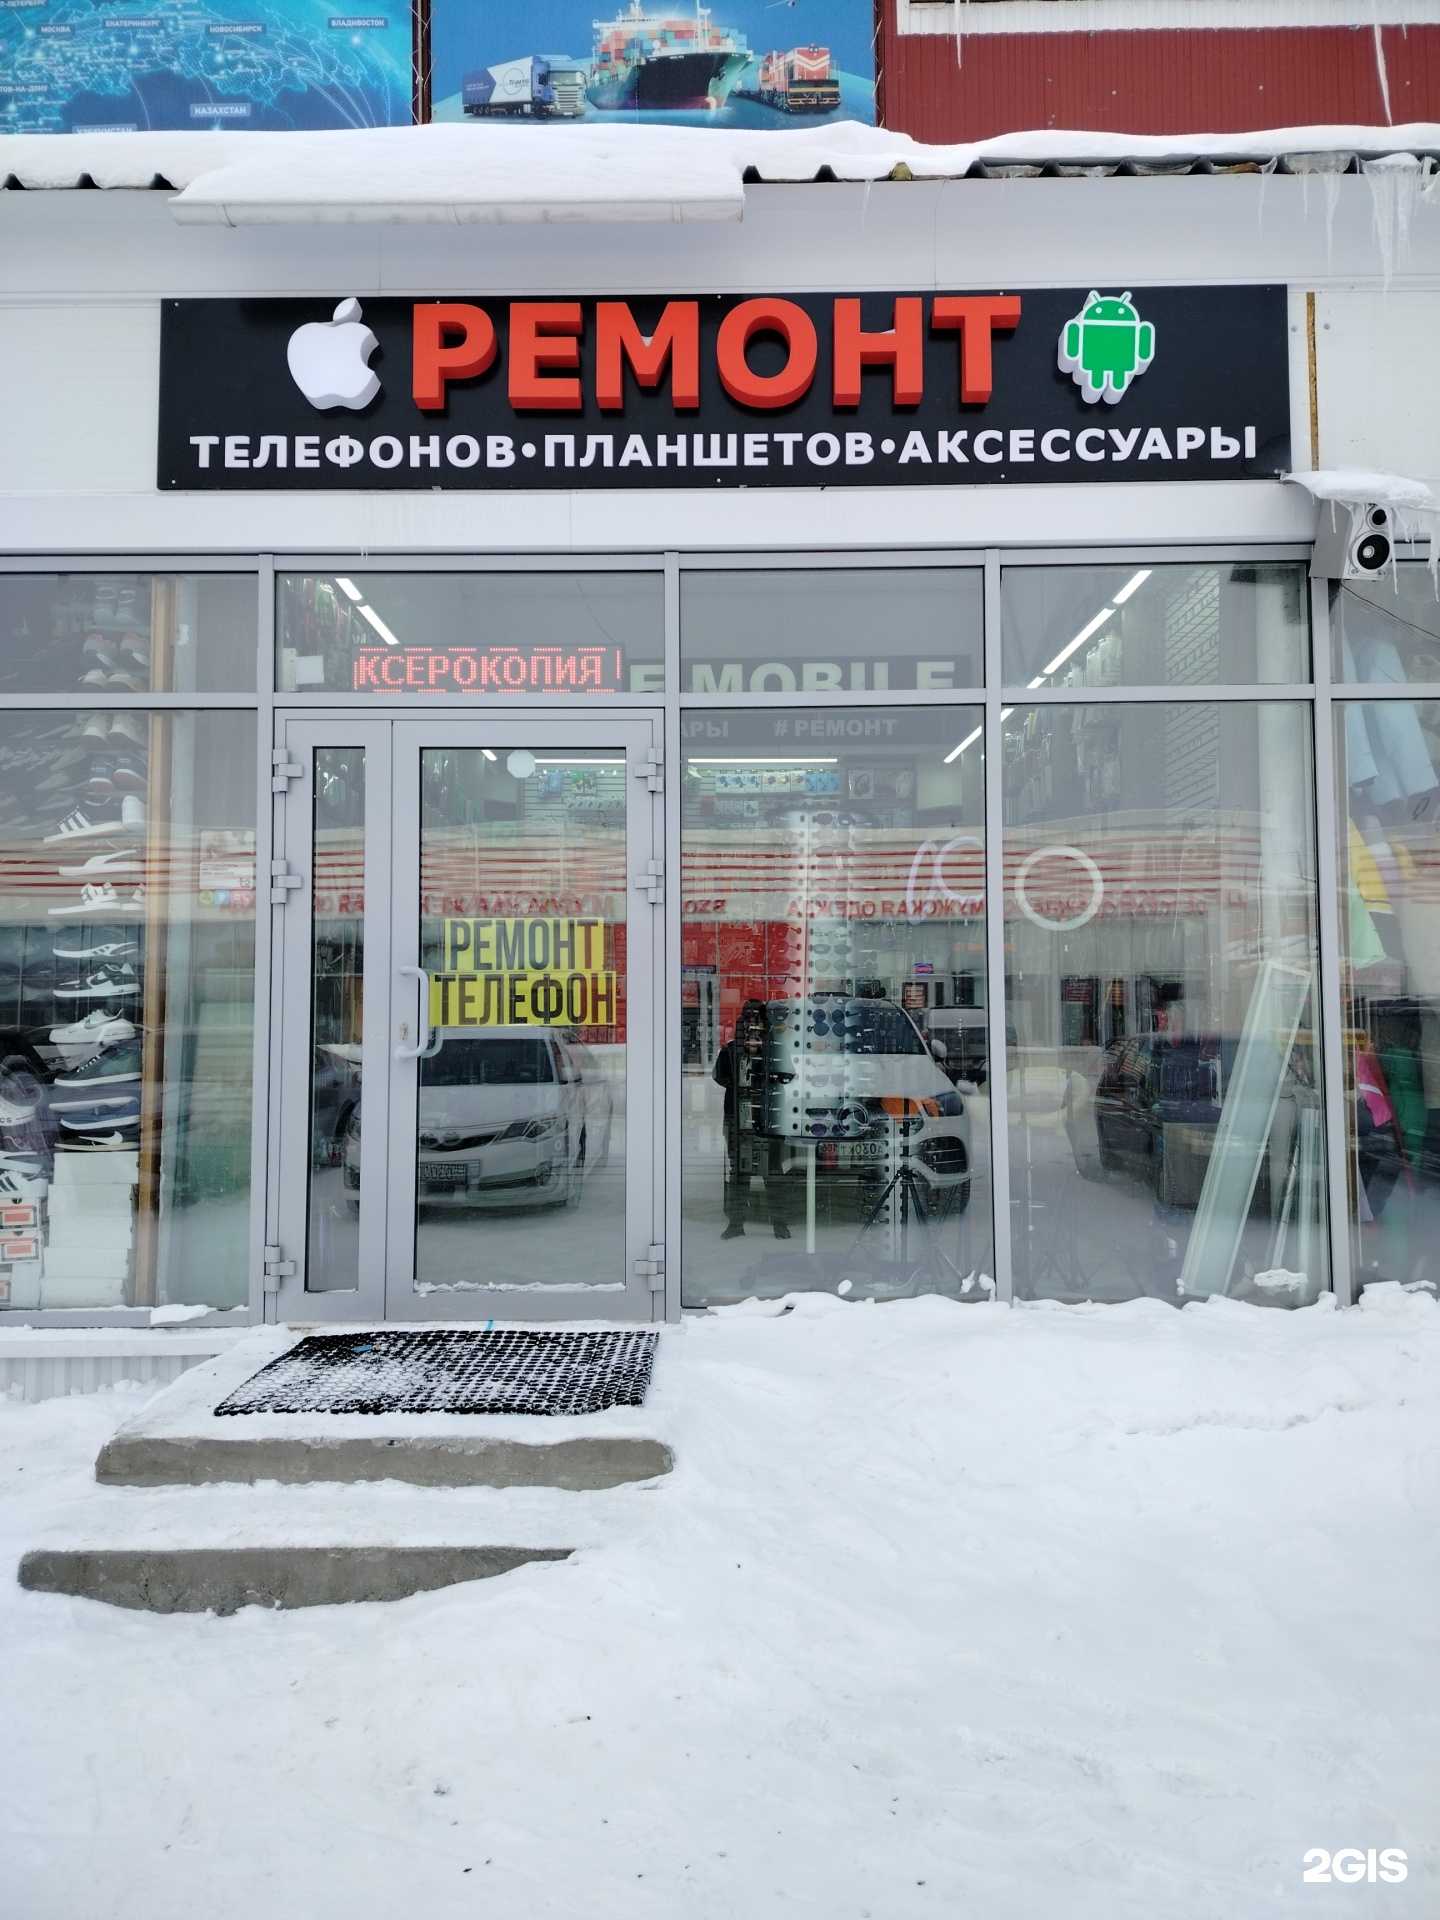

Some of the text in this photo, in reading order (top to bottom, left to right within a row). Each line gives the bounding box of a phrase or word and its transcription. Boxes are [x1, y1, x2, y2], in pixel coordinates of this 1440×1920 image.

[41, 25, 71, 33] МОСКВА
[209, 25, 262, 33] НОВОСИБИРСК
[331, 19, 385, 27] ВЛАДИВОСТОК
[194, 106, 247, 115] КАЗАХСТАН
[411, 295, 1021, 411] РЕМОНТ
[189, 425, 1257, 468] ТЕЛЕФОНОВ ПЛАНШЕТОВ АКСЕССУАРЫ
[359, 655, 602, 686] КСЕРОКОПИЯ
[452, 918, 600, 971] РЕМОНТ
[434, 973, 613, 1025] ТЕЛЕФОН
